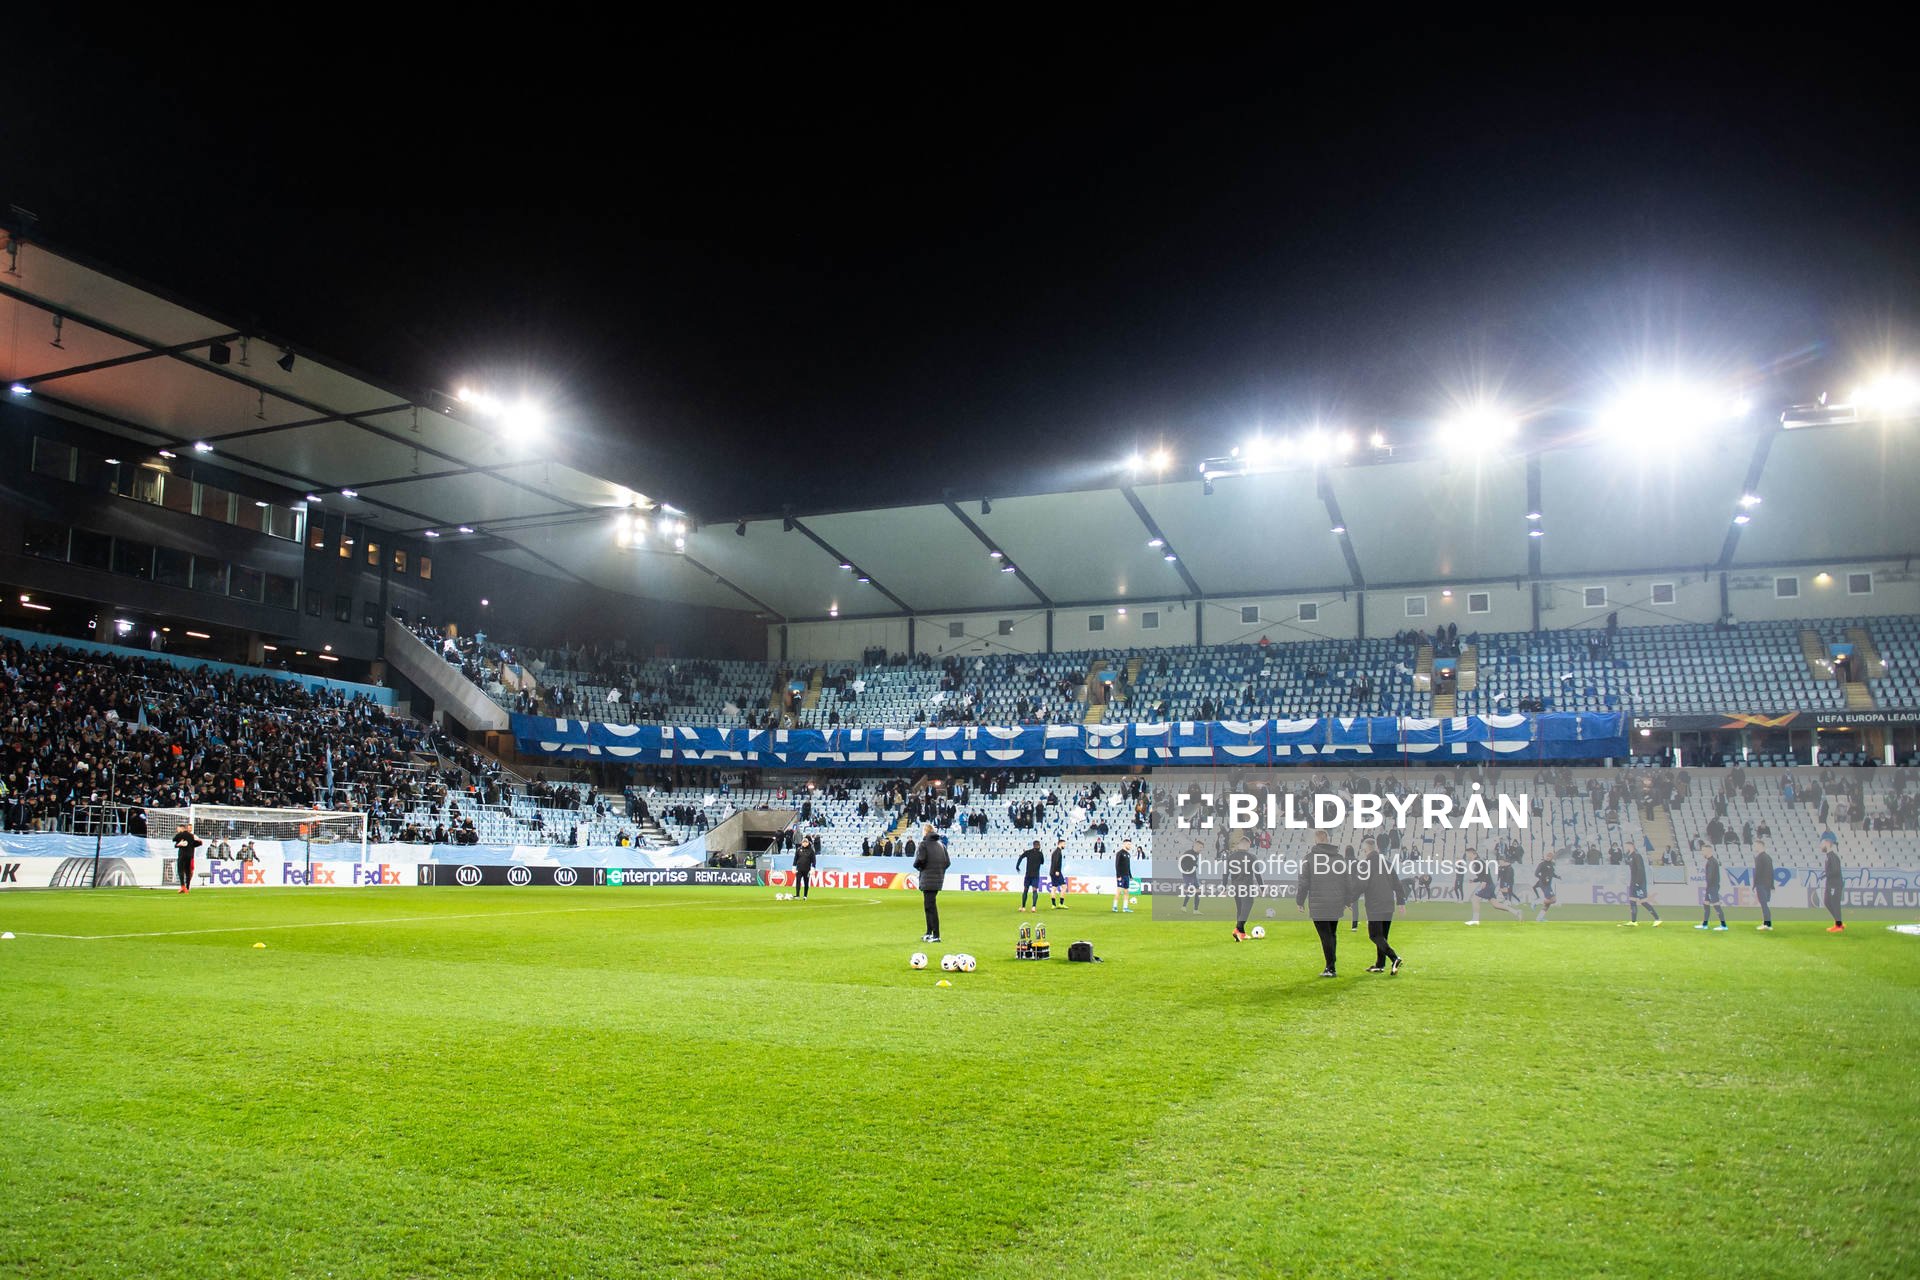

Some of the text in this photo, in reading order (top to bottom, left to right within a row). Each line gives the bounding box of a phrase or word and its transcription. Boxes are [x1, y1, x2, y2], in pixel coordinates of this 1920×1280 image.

[1816, 715, 1844, 724] UEFA
[1846, 714, 1886, 723] EUROPA
[209, 860, 265, 885] FedEx
[283, 861, 335, 885] FedEx
[353, 862, 401, 885] FedEx
[460, 869, 479, 882] KIA
[511, 870, 529, 882] KIA
[558, 871, 574, 882] KIA
[608, 867, 688, 886] enterprise
[695, 871, 752, 884] RENT-A-CAR
[961, 875, 1009, 892] FedEx
[1892, 891, 1920, 907] EU
